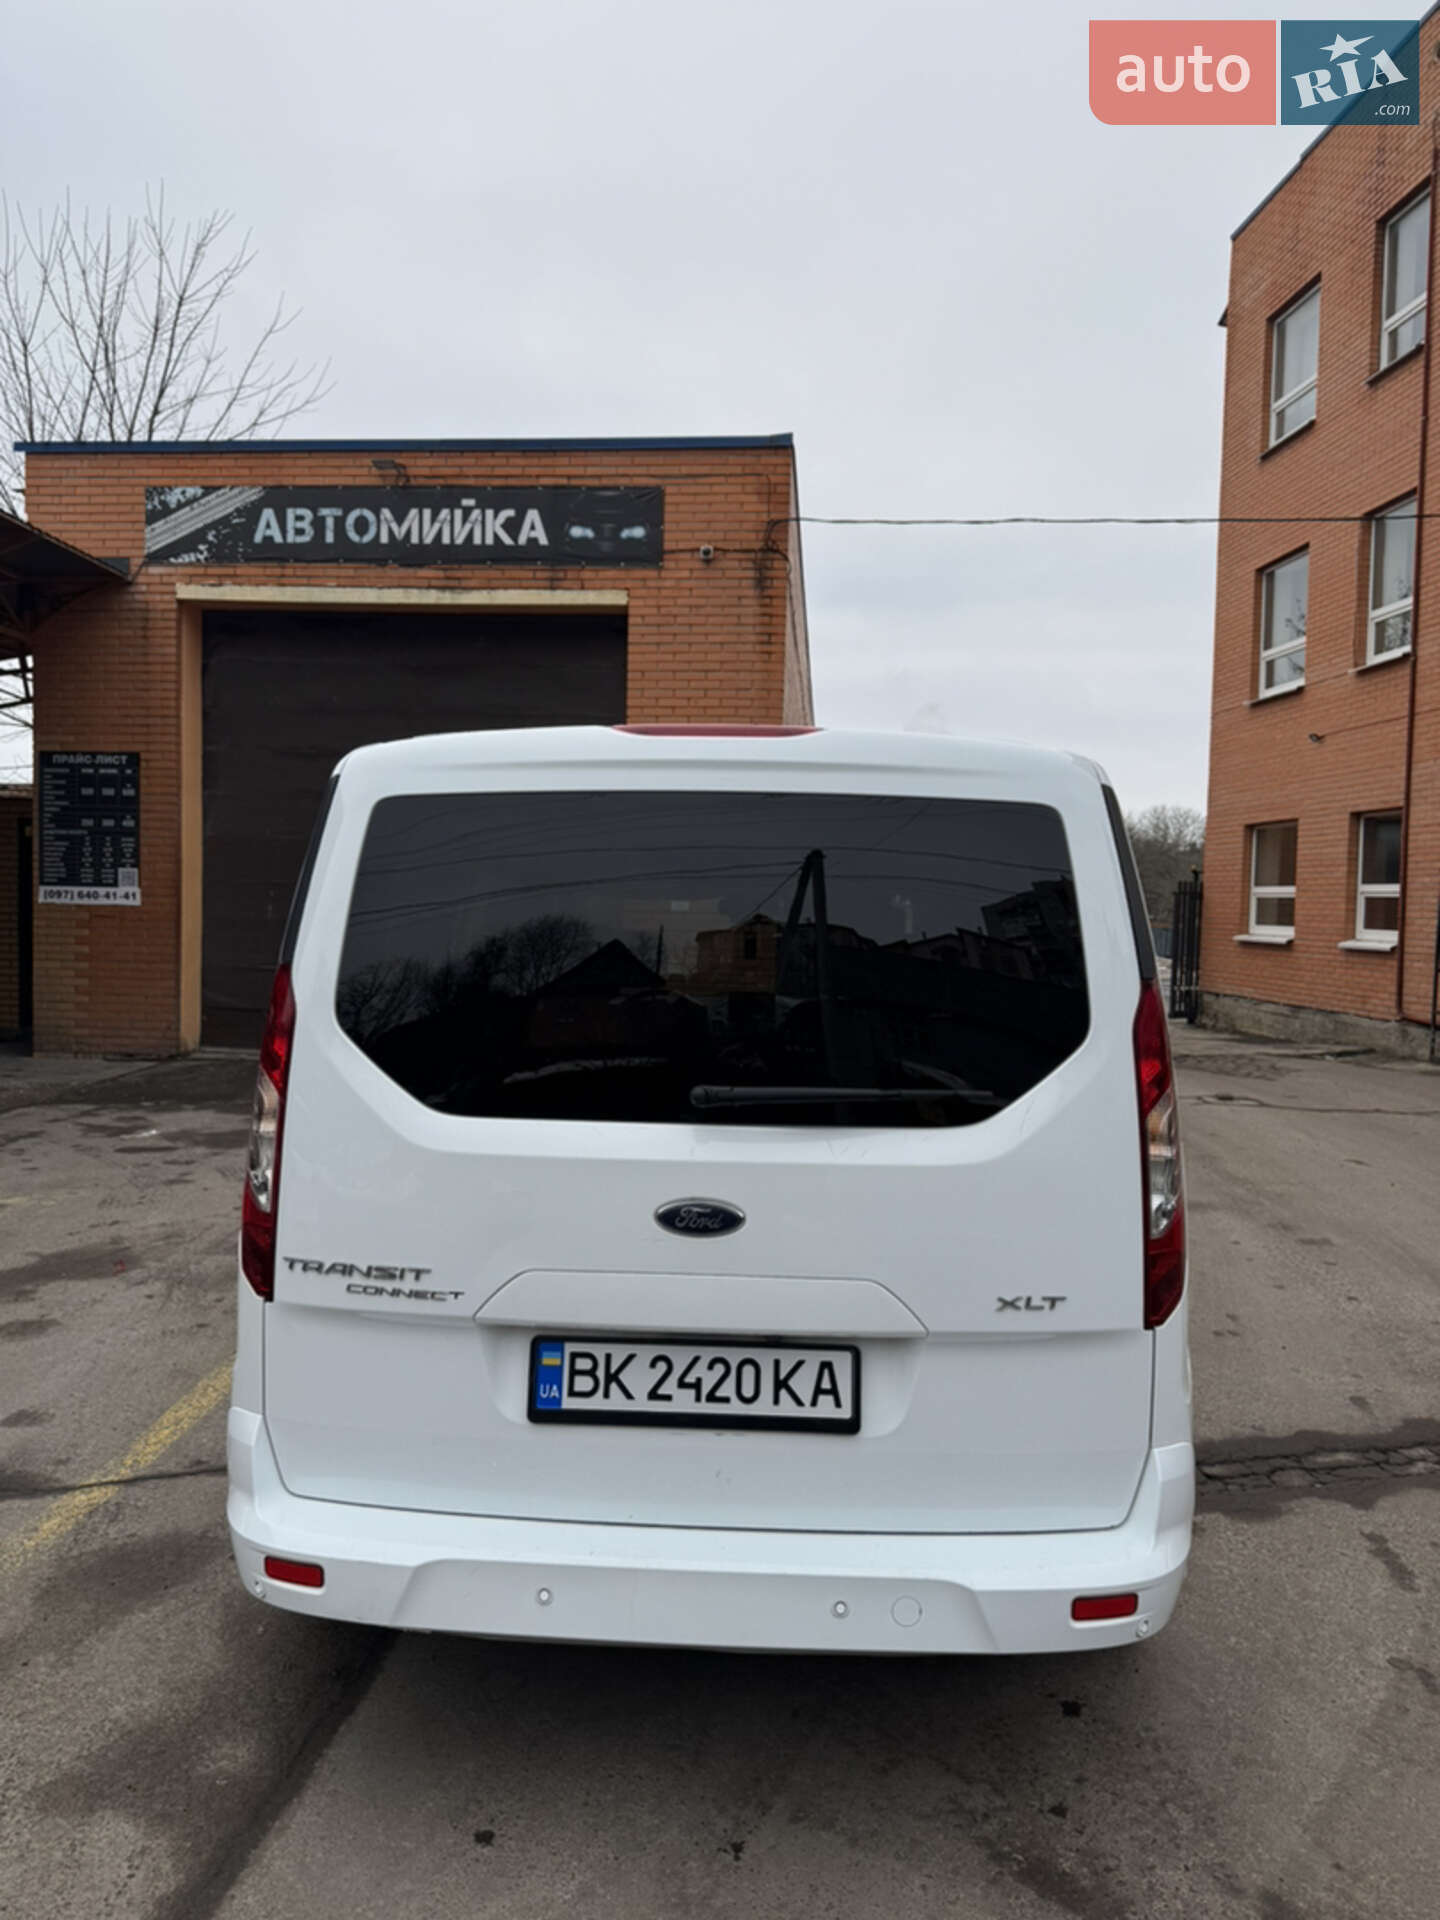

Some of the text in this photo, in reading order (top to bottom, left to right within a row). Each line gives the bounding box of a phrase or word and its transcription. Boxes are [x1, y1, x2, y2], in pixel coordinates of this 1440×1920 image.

[253, 498, 549, 547] АВТОМИЙКА
[674, 1206, 724, 1229] Ford
[282, 1256, 432, 1282] TRANSIT
[345, 1283, 465, 1301] CONNECT
[995, 1295, 1068, 1312] XLT
[567, 1351, 842, 1408] BK 2420 KA
[539, 1385, 560, 1399] UA
